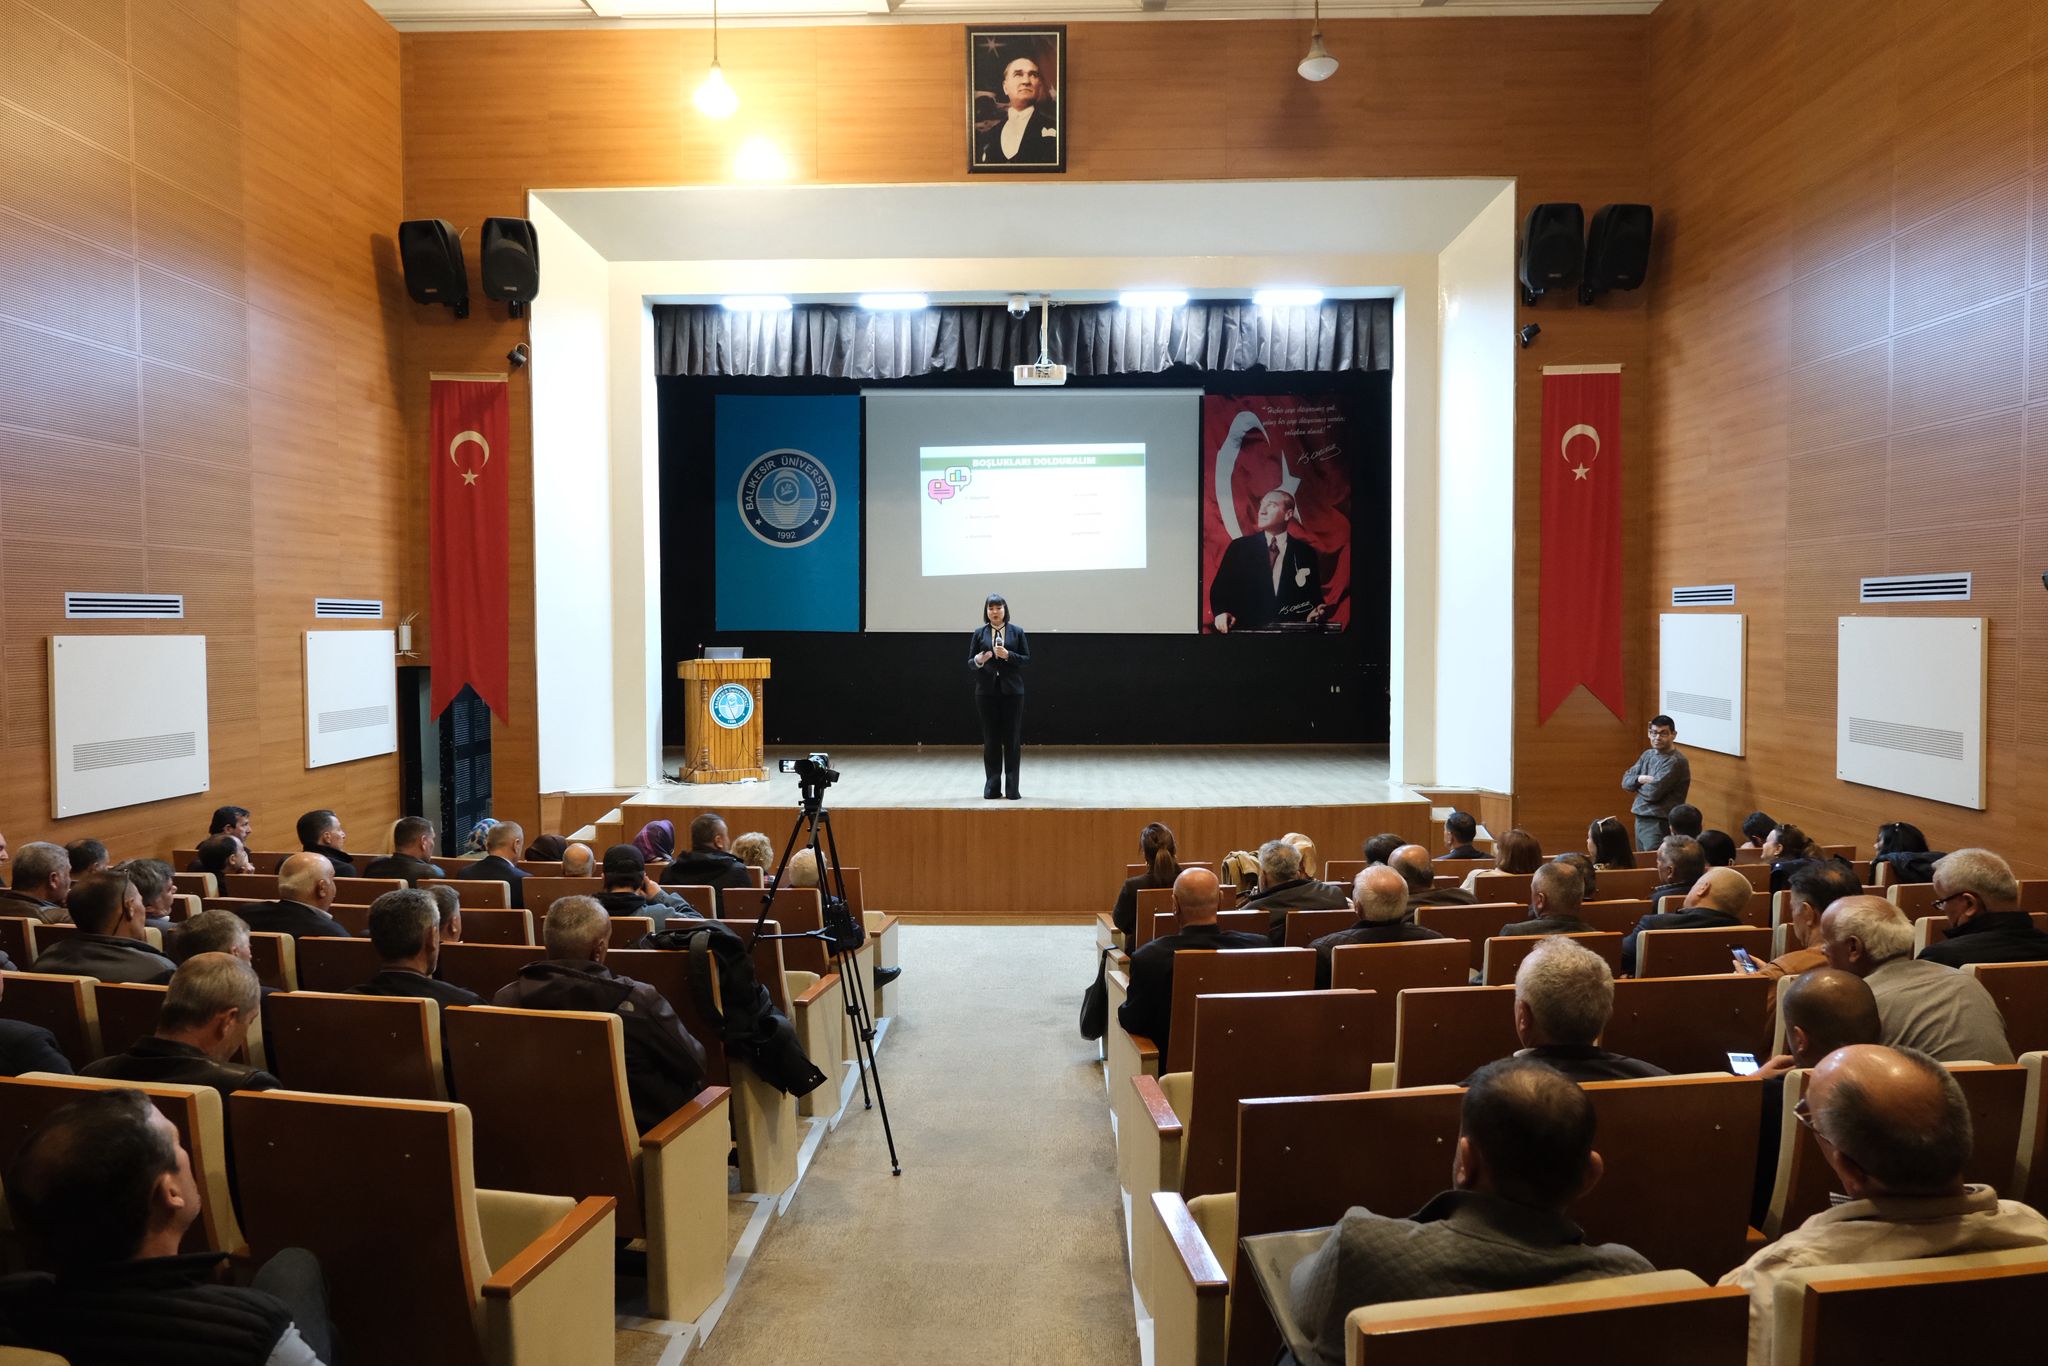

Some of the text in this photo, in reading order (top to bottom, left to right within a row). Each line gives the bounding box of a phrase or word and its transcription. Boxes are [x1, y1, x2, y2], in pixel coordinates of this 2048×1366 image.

[972, 456, 1097, 469] BOŞLUKLARI DOLDURALIM
[745, 455, 831, 512] BALIKESİR ÜNİVERSİTESİ
[777, 531, 797, 540] 1992
